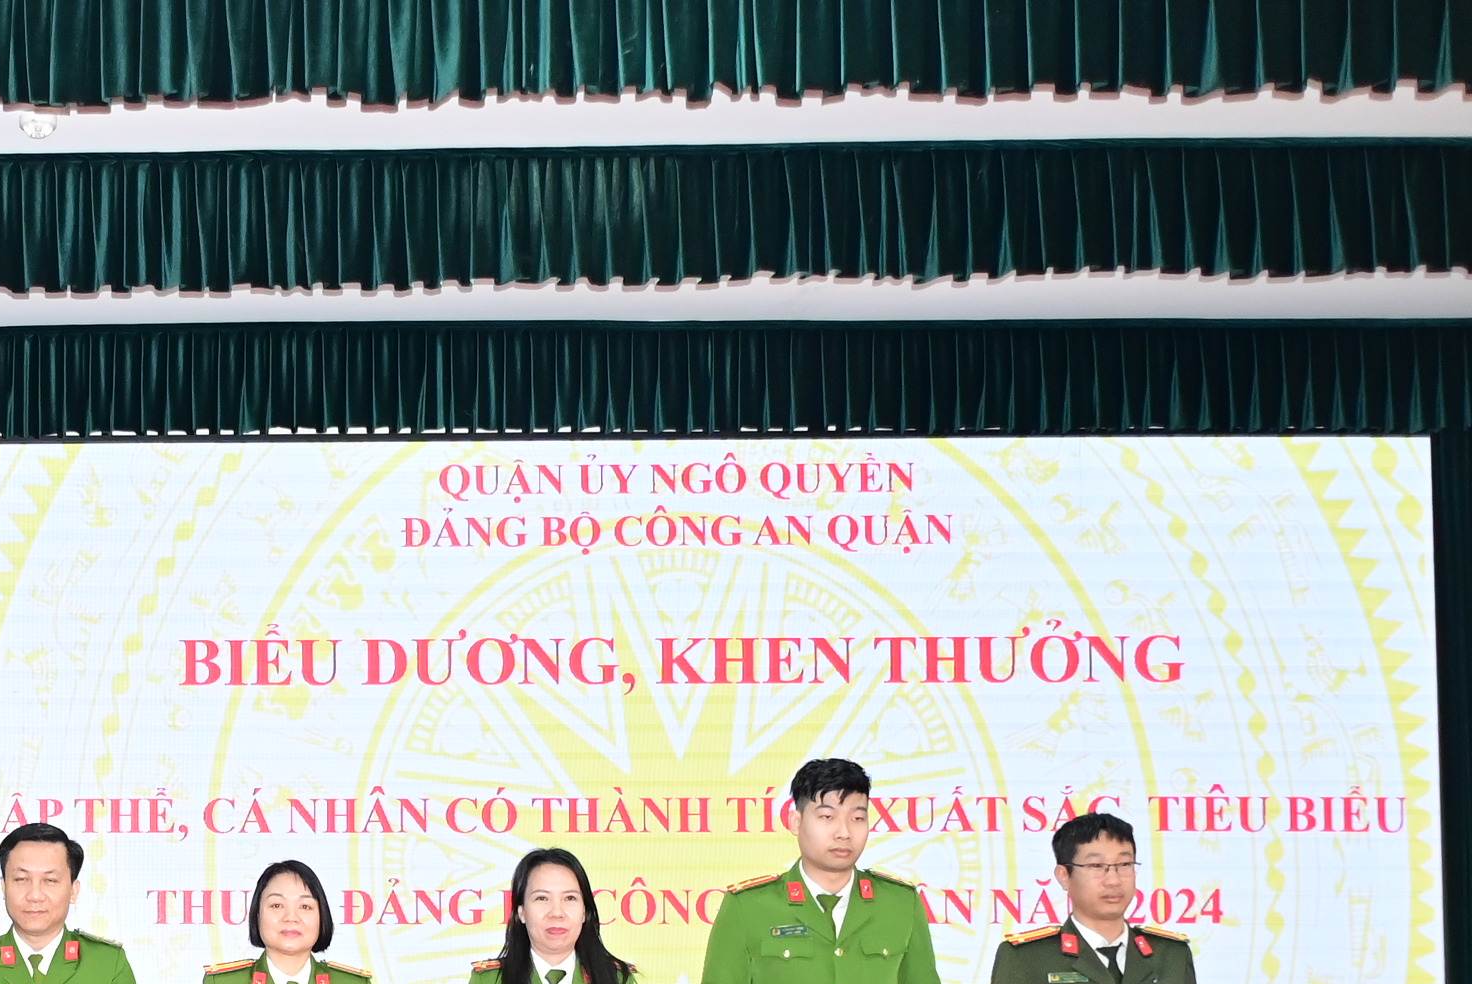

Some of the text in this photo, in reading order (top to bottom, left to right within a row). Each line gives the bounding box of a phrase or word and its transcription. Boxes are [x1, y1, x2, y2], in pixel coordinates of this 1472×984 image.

[439, 452, 915, 503] QUẬN ỦY NGÔ QUYỀN
[401, 505, 953, 555] ĐẢNG BỘ CÔNG AN QUẬN
[178, 619, 1186, 695] BIỂU DƯƠNG, KHEN THƯỞNG
[74, 787, 189, 842] THỂ,
[203, 787, 272, 834] CÁ
[286, 785, 430, 834] NHÂN
[445, 787, 518, 834] CÓ
[532, 787, 712, 834] THÀNH
[869, 785, 1008, 833] XUẤT
[1148, 783, 1268, 833] TIÊU
[1285, 785, 1407, 833] BIỂU
[146, 889, 253, 925] THU
[339, 877, 485, 925] ĐẢNG
[990, 878, 1073, 925] NĂ
[1128, 888, 1223, 925] 2024
